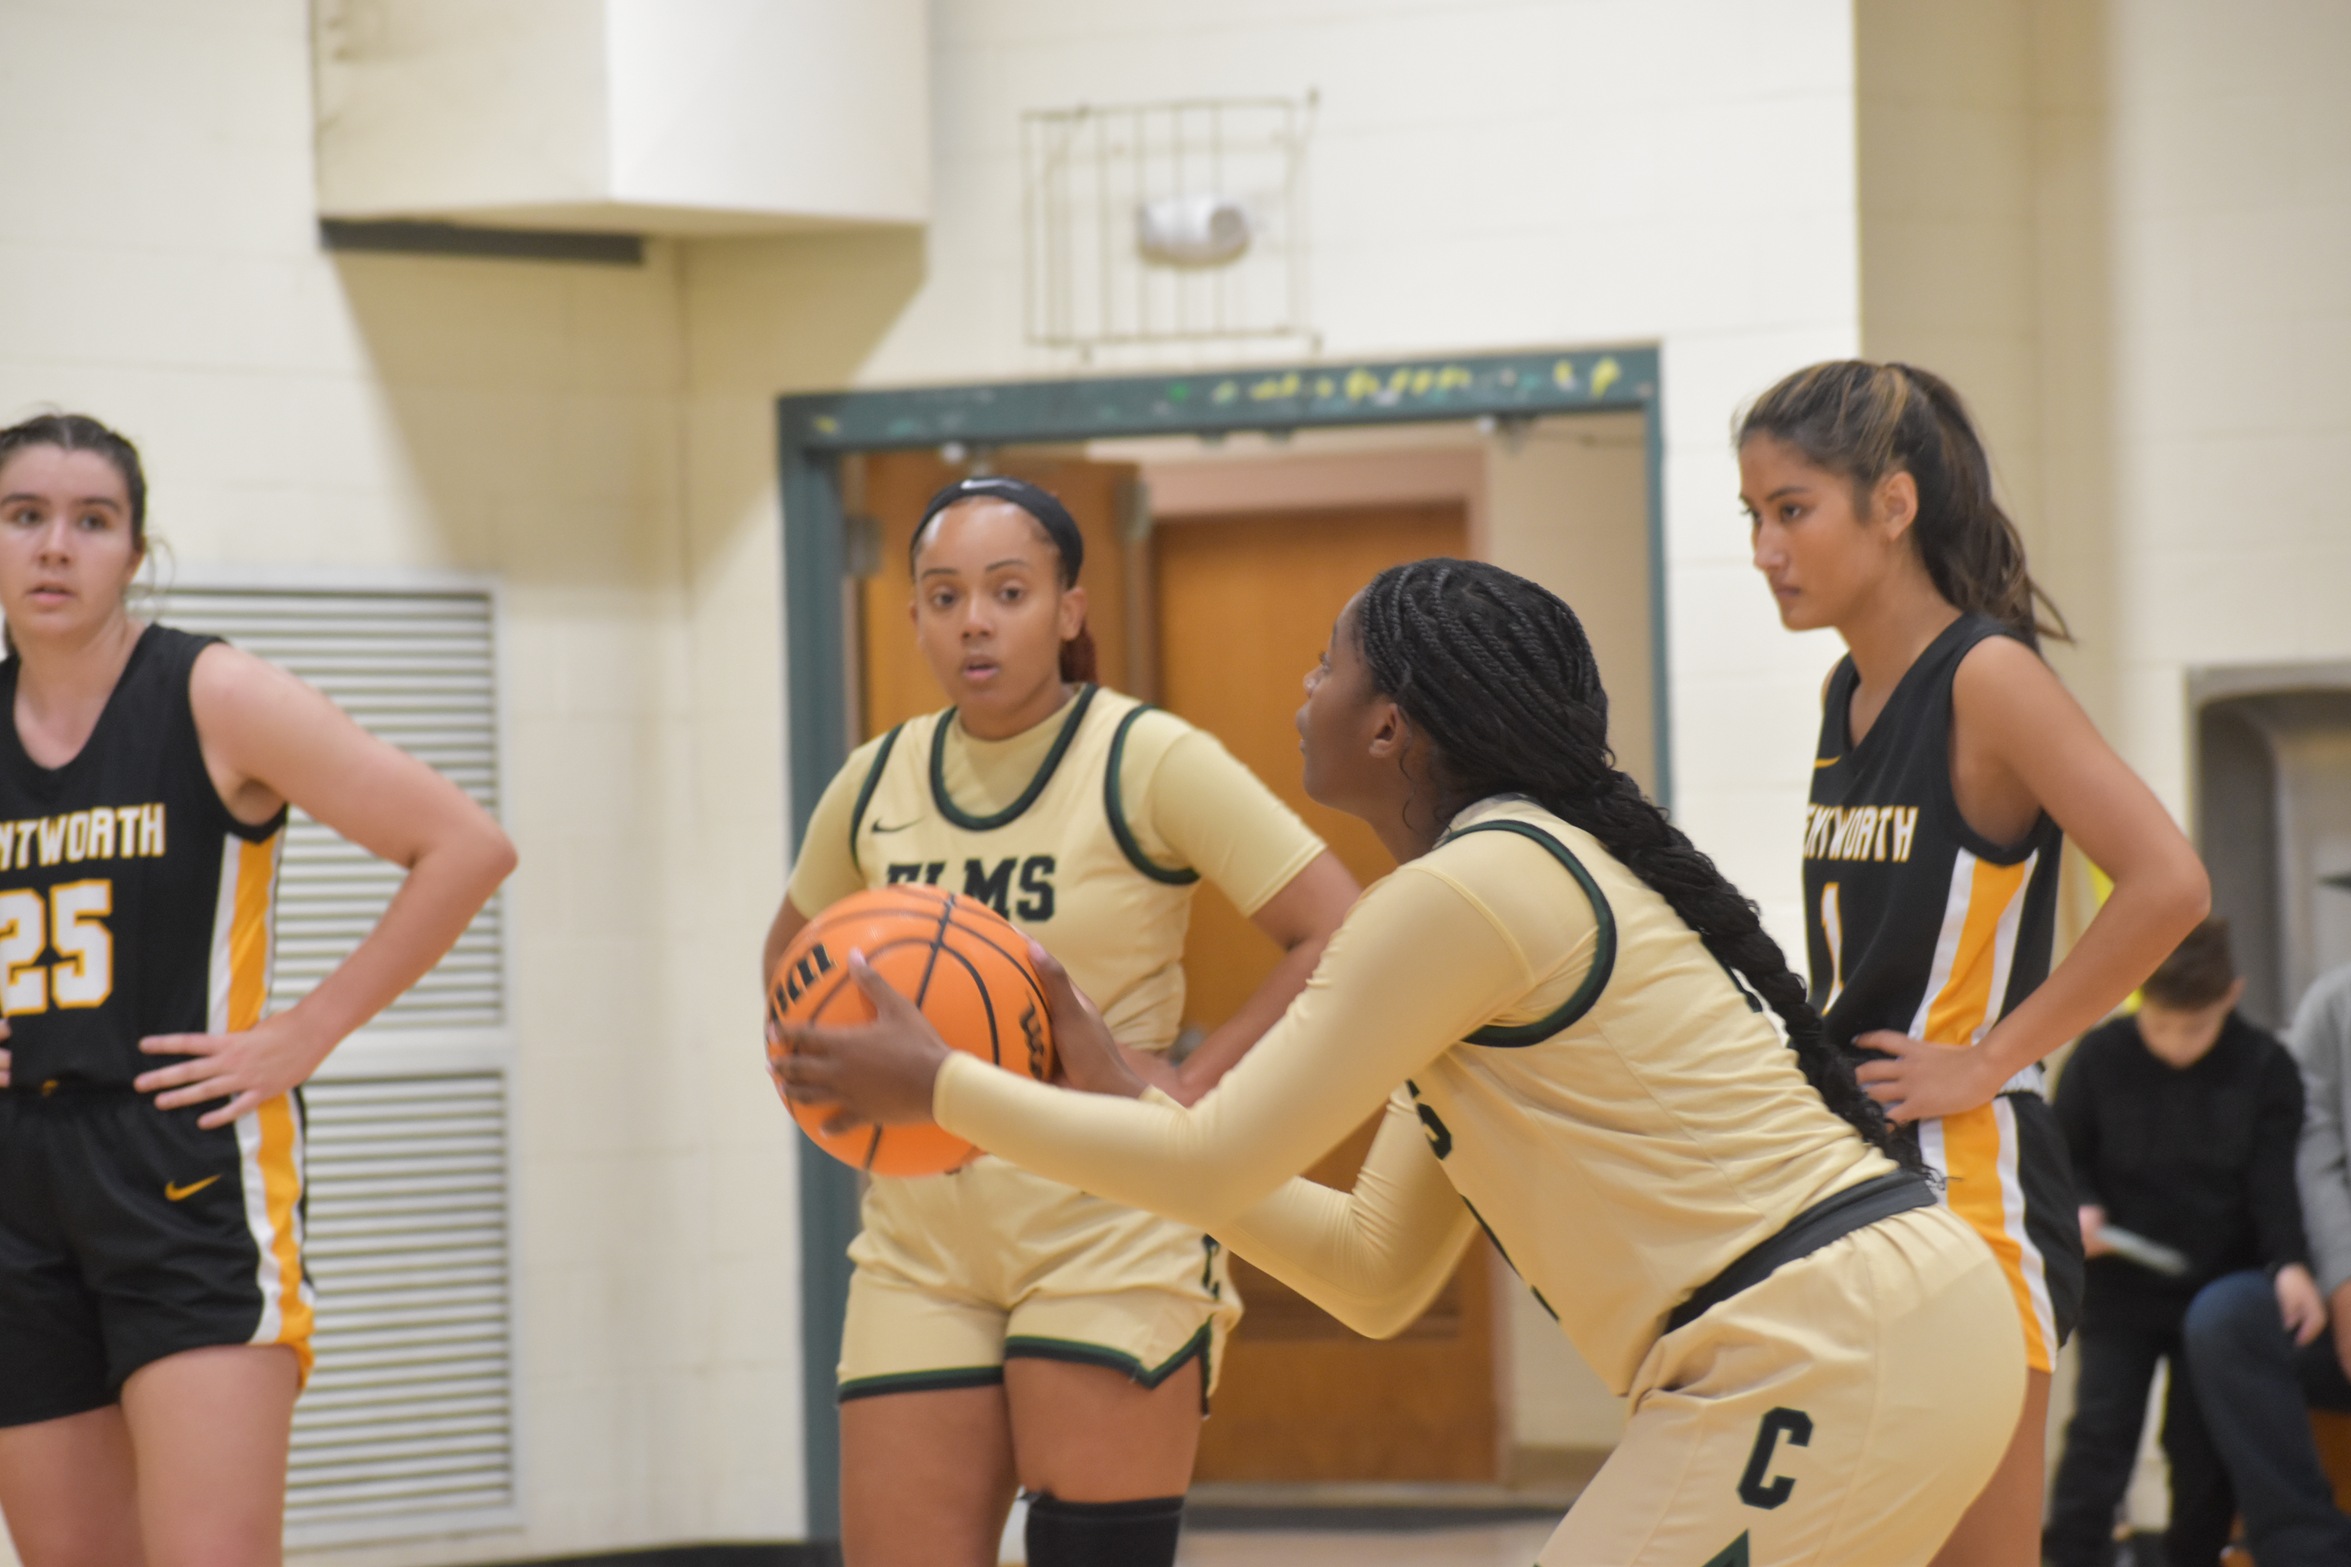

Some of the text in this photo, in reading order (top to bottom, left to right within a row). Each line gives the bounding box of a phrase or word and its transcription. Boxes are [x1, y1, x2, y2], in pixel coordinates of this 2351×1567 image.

[0, 879, 114, 1017] 25
[1820, 882, 1845, 1016] 1
[1736, 1406, 1814, 1510] C
